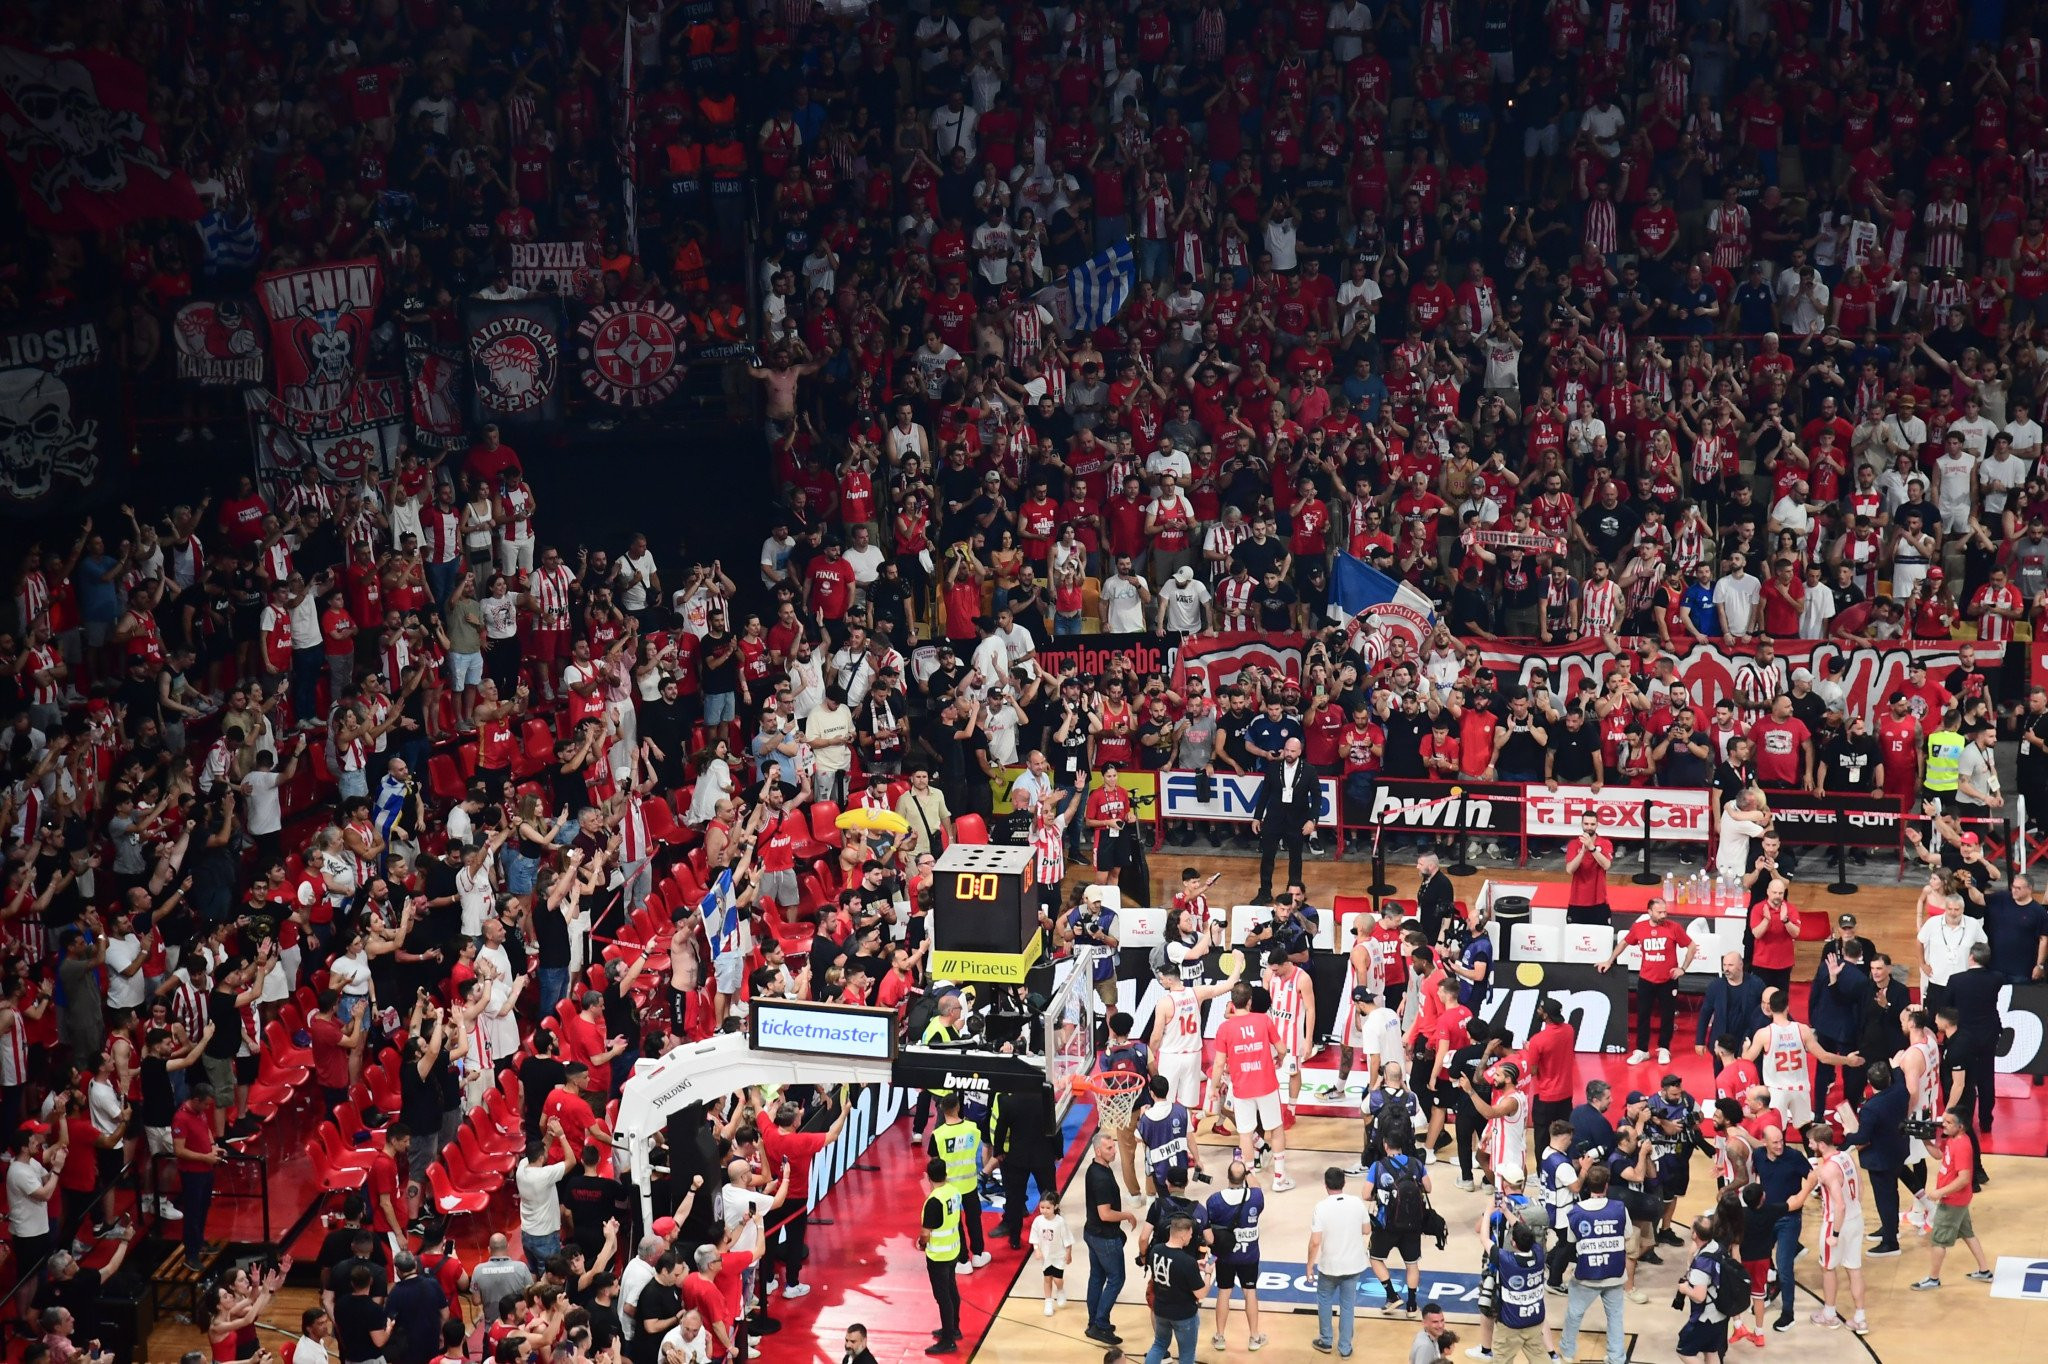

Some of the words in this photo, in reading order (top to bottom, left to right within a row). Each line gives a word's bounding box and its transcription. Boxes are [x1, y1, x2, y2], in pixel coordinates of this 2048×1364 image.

[577, 300, 688, 340] BRIGADE
[580, 364, 689, 407] GLYFADA
[1536, 435, 1560, 445] bwin
[1695, 464, 1719, 474] bwin
[846, 489, 869, 500] bwin
[815, 571, 840, 582] FINAL
[1175, 594, 1194, 604] VANS
[1369, 786, 1494, 829] bwin
[1771, 811, 1837, 825] NEVER
[1848, 813, 1900, 827] QUIT
[955, 873, 999, 901] 0:0
[1520, 944, 1543, 952] FlexCar
[1574, 944, 1598, 952] FlexCar
[1644, 937, 1666, 950] OLY
[961, 960, 1018, 977] Piraeus
[761, 1018, 878, 1043] ticketmaster
[1179, 1014, 1197, 1036] 16
[1240, 1025, 1255, 1040] 14
[1234, 1041, 1263, 1054] FMS
[1774, 1051, 1803, 1072] 25
[943, 1072, 990, 1090] bwin
[652, 1078, 692, 1108] SPALDING
[1593, 1224, 1617, 1235] GBL
[1598, 1239, 1620, 1249] HOLDER
